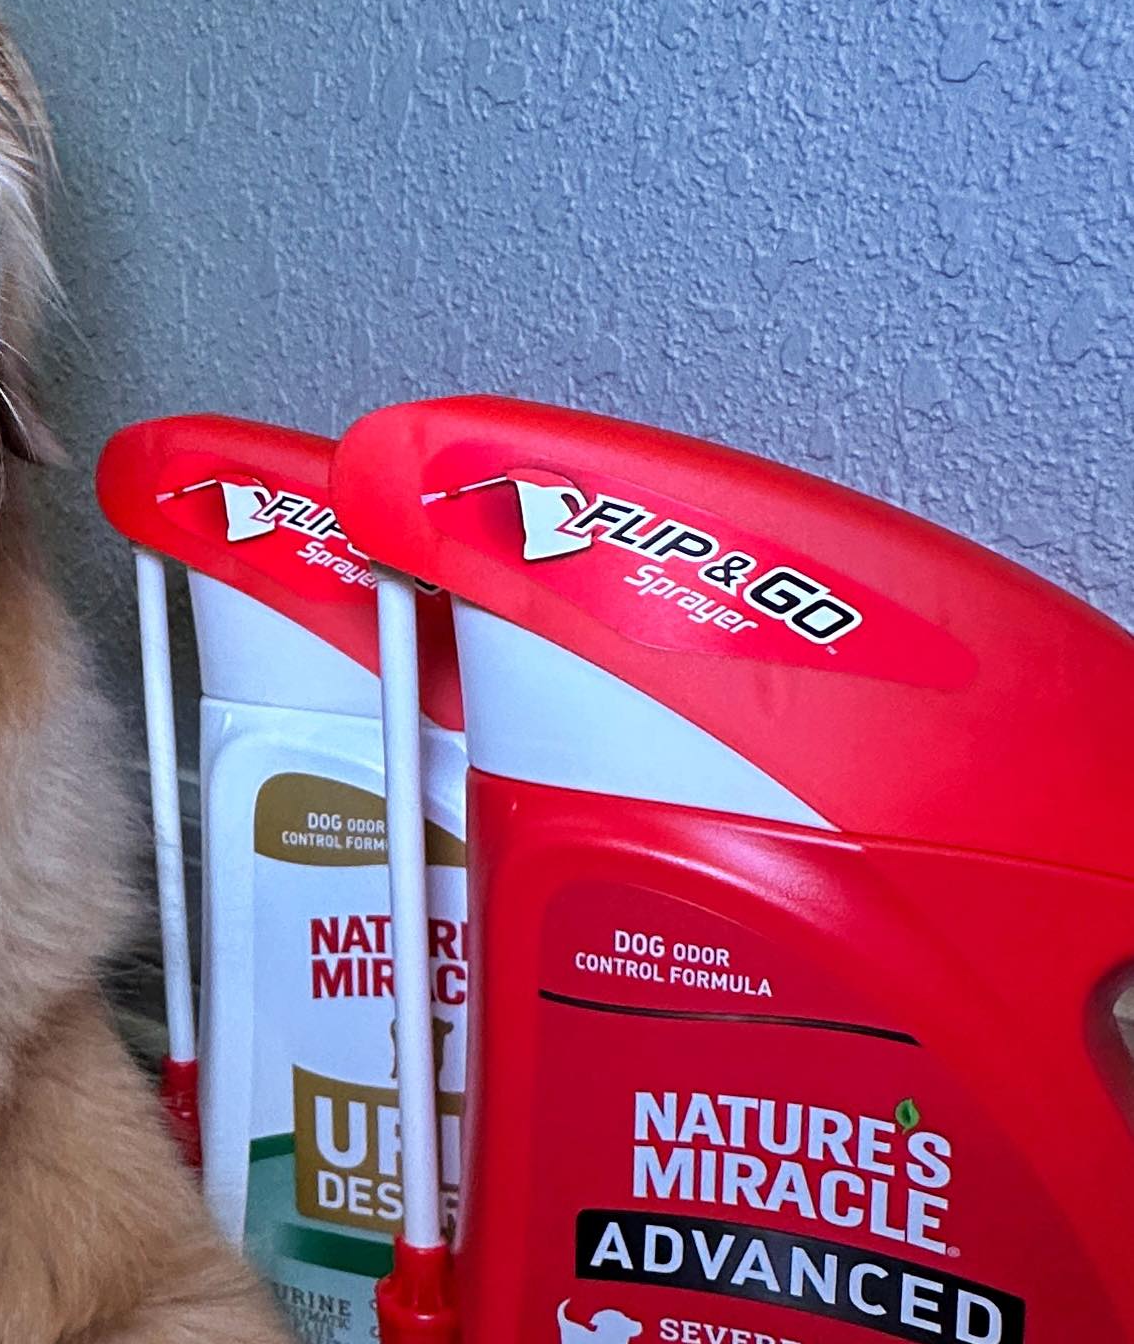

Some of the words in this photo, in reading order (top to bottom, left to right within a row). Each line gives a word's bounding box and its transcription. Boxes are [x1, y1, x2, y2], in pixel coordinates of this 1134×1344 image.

[624, 564, 759, 635] Sprayer
[282, 830, 343, 849] CONTROL
[345, 835, 389, 851] FORM
[307, 812, 342, 831] DOG
[347, 818, 386, 834] ODOR
[310, 915, 469, 961] NATR
[614, 930, 665, 958] DOG
[672, 943, 730, 968] ODOR
[575, 952, 664, 984] CONTROL
[669, 966, 773, 998] FORMULA
[632, 1145, 949, 1256] MIRACLE
[271, 1281, 352, 1318] URINE
